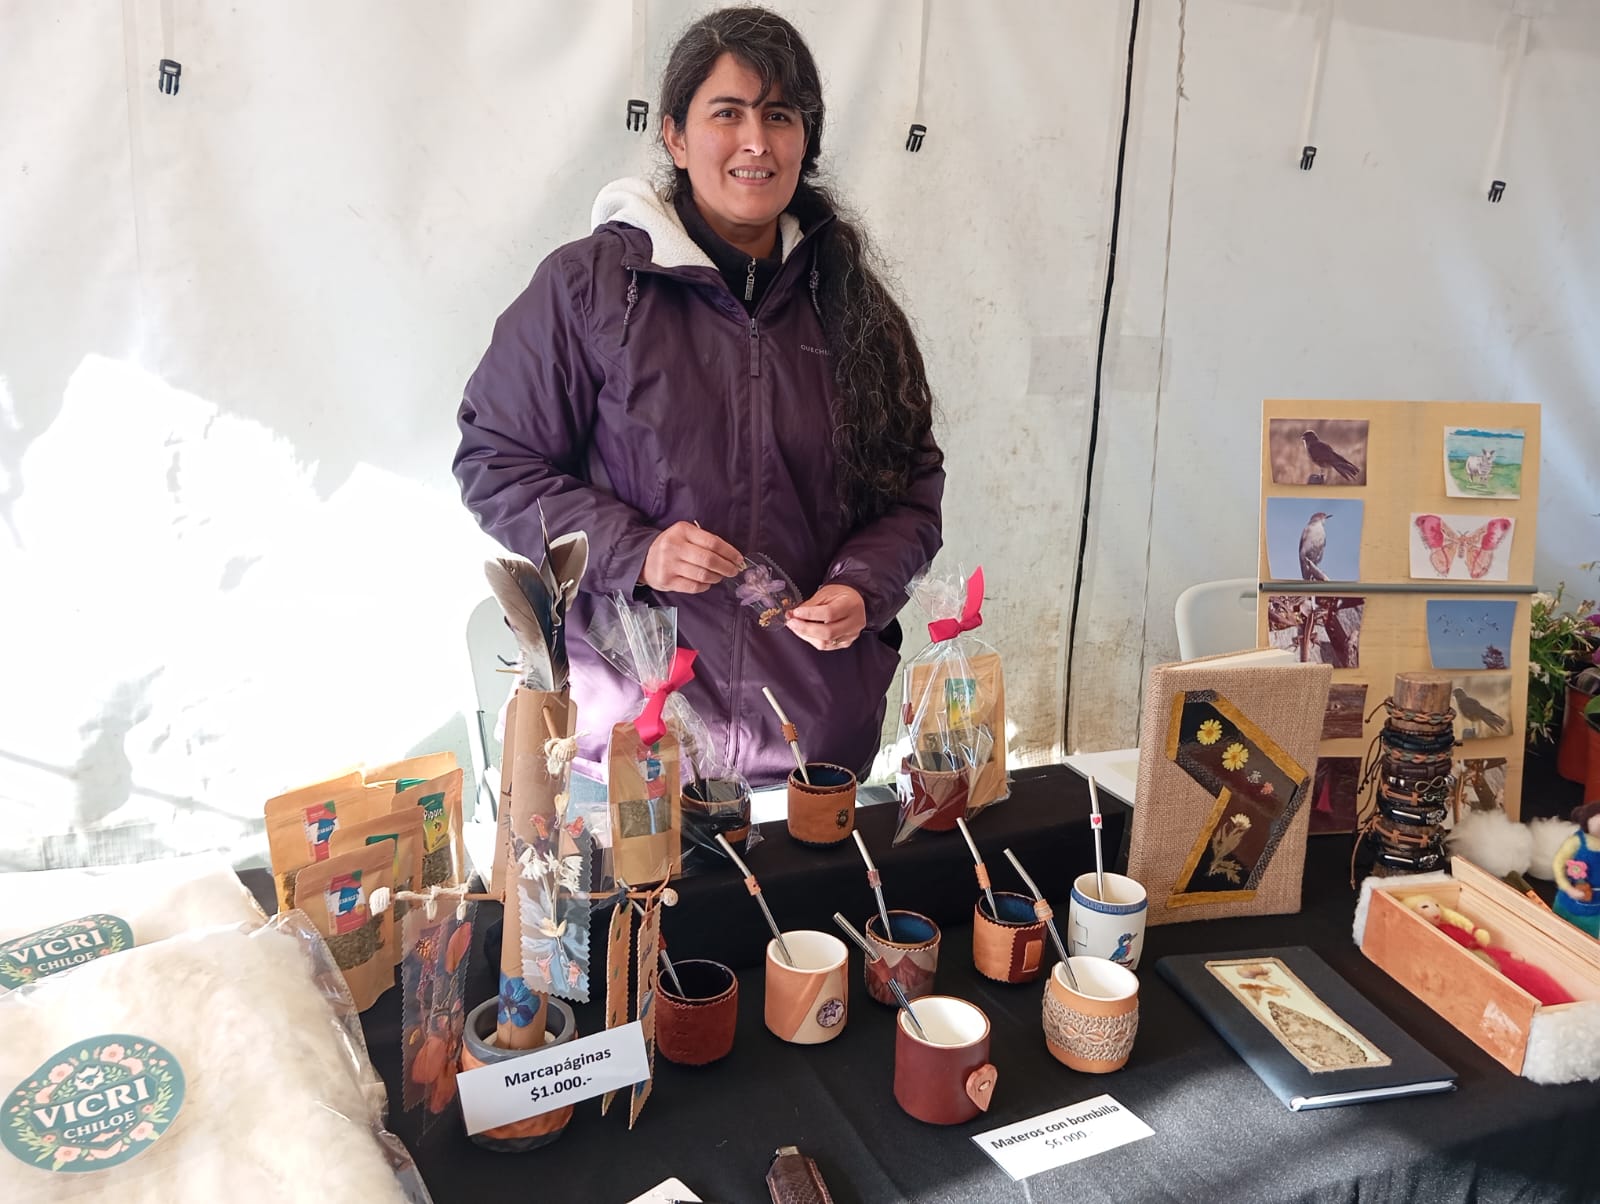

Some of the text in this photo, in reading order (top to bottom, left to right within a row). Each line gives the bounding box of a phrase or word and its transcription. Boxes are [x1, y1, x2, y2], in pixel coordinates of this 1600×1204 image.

[800, 343, 831, 356] QUECHU
[8, 928, 105, 964] VICRI
[37, 951, 95, 972] CHILOE
[504, 1048, 612, 1087] Marcapáginas
[34, 1077, 150, 1128] VICRI
[530, 1075, 592, 1102] $1.000.-
[63, 1110, 136, 1140] CHILOE
[991, 1103, 1120, 1149] Materos con bombilla
[1045, 1130, 1094, 1149] $6000-
